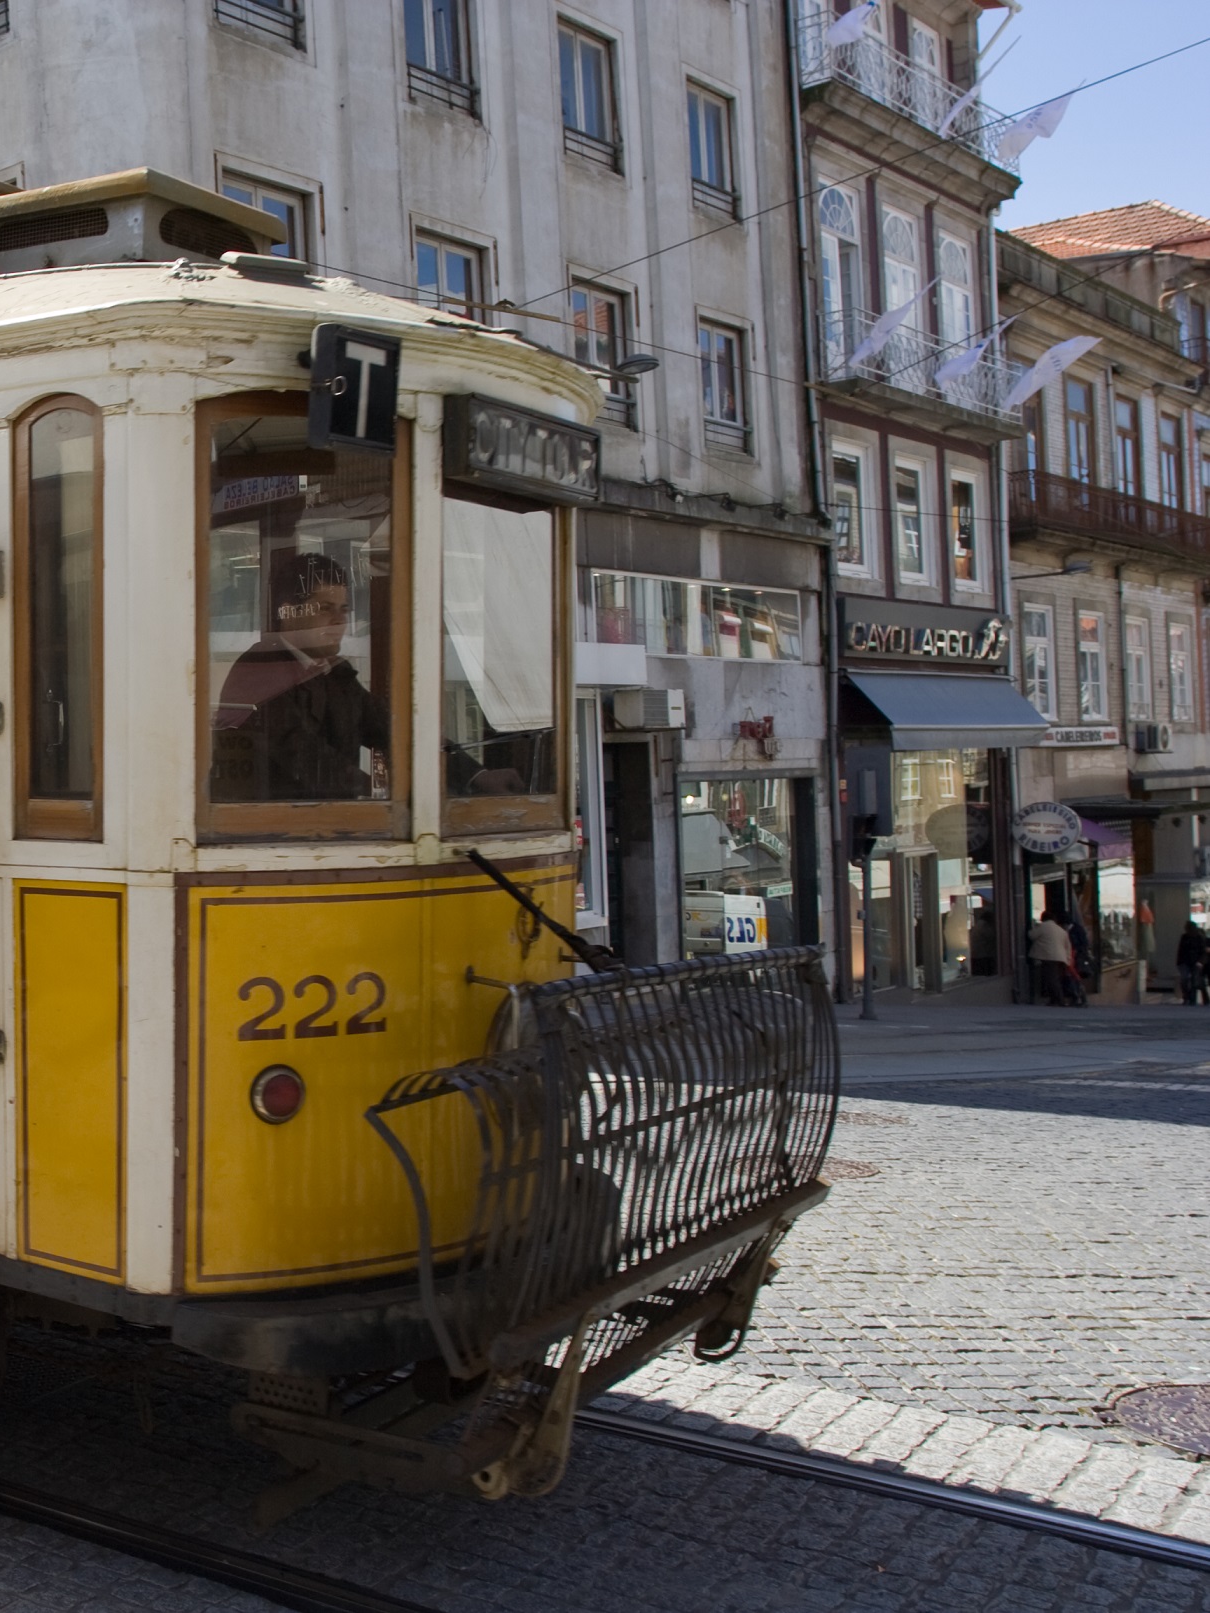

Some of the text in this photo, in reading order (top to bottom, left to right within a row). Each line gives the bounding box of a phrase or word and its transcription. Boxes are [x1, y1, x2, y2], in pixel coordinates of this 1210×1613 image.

[345, 341, 387, 438] T
[470, 410, 531, 474] CITY
[850, 621, 973, 658] CAYO LARGO
[1014, 802, 1076, 830] CABELEIREIRO
[1018, 833, 1070, 851] RIBEIRO
[238, 972, 387, 1041] 222
